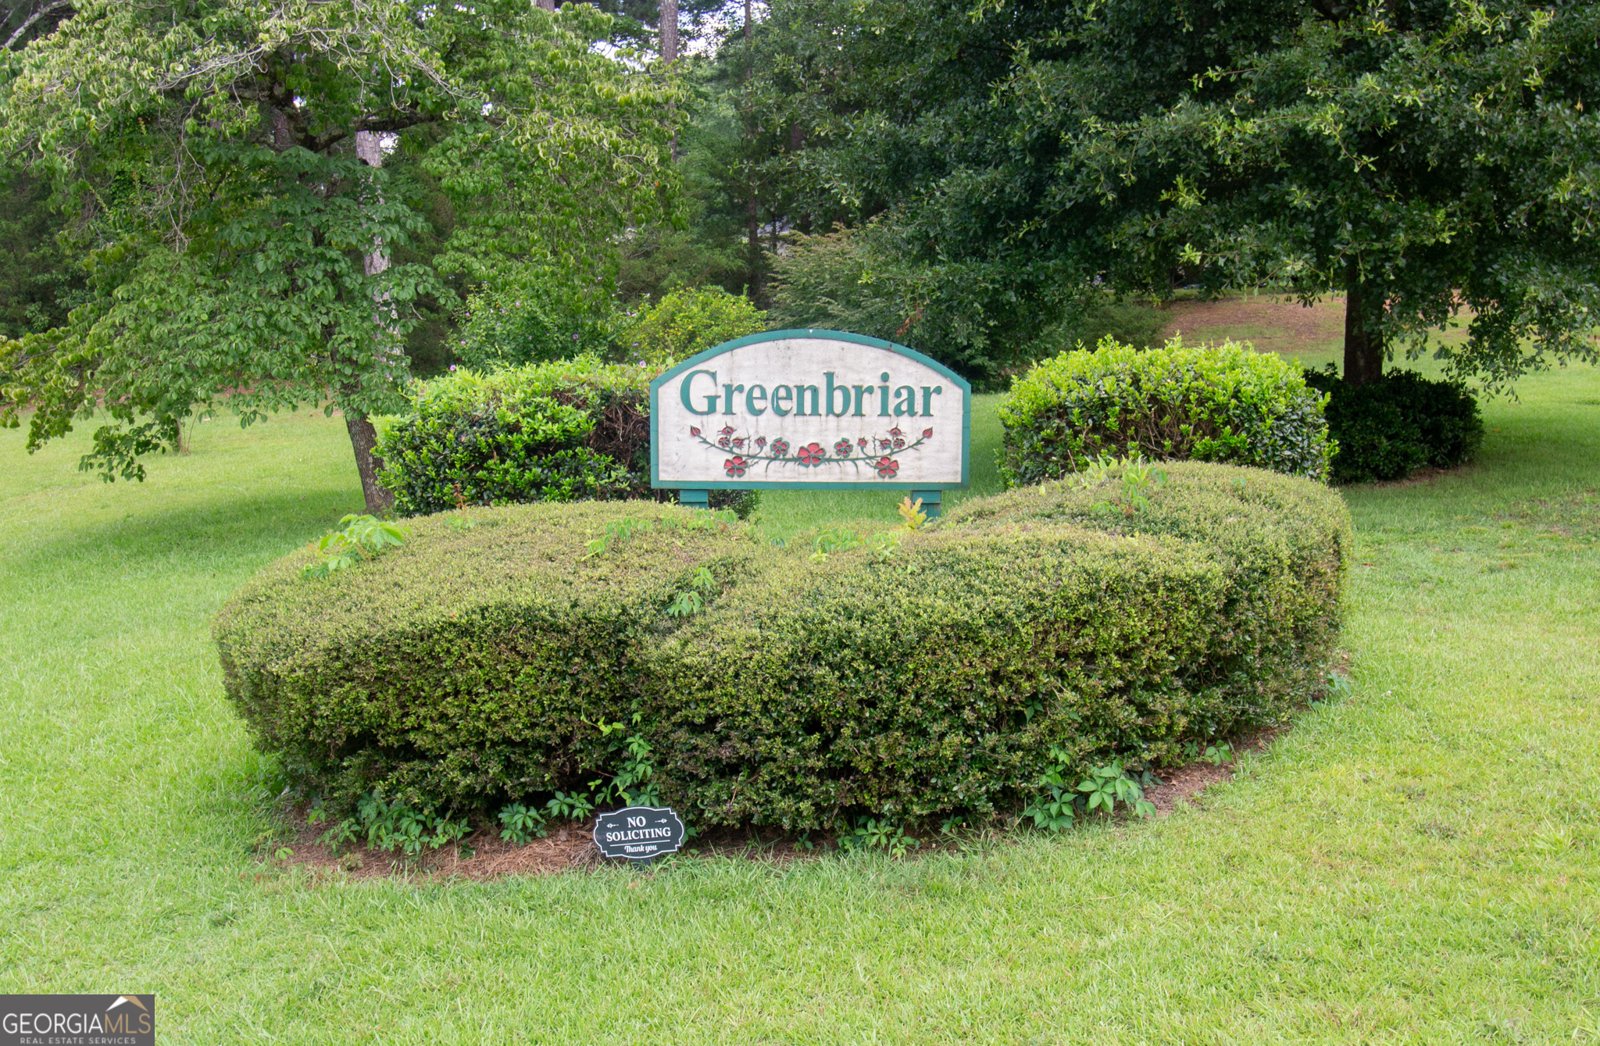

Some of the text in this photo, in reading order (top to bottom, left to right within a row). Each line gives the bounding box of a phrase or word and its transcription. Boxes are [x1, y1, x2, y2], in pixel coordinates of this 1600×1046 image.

[679, 369, 943, 417] Greenbriar
[627, 816, 646, 828] NO
[606, 827, 671, 842] SOLICITING
[624, 845, 657, 853] Thank you
